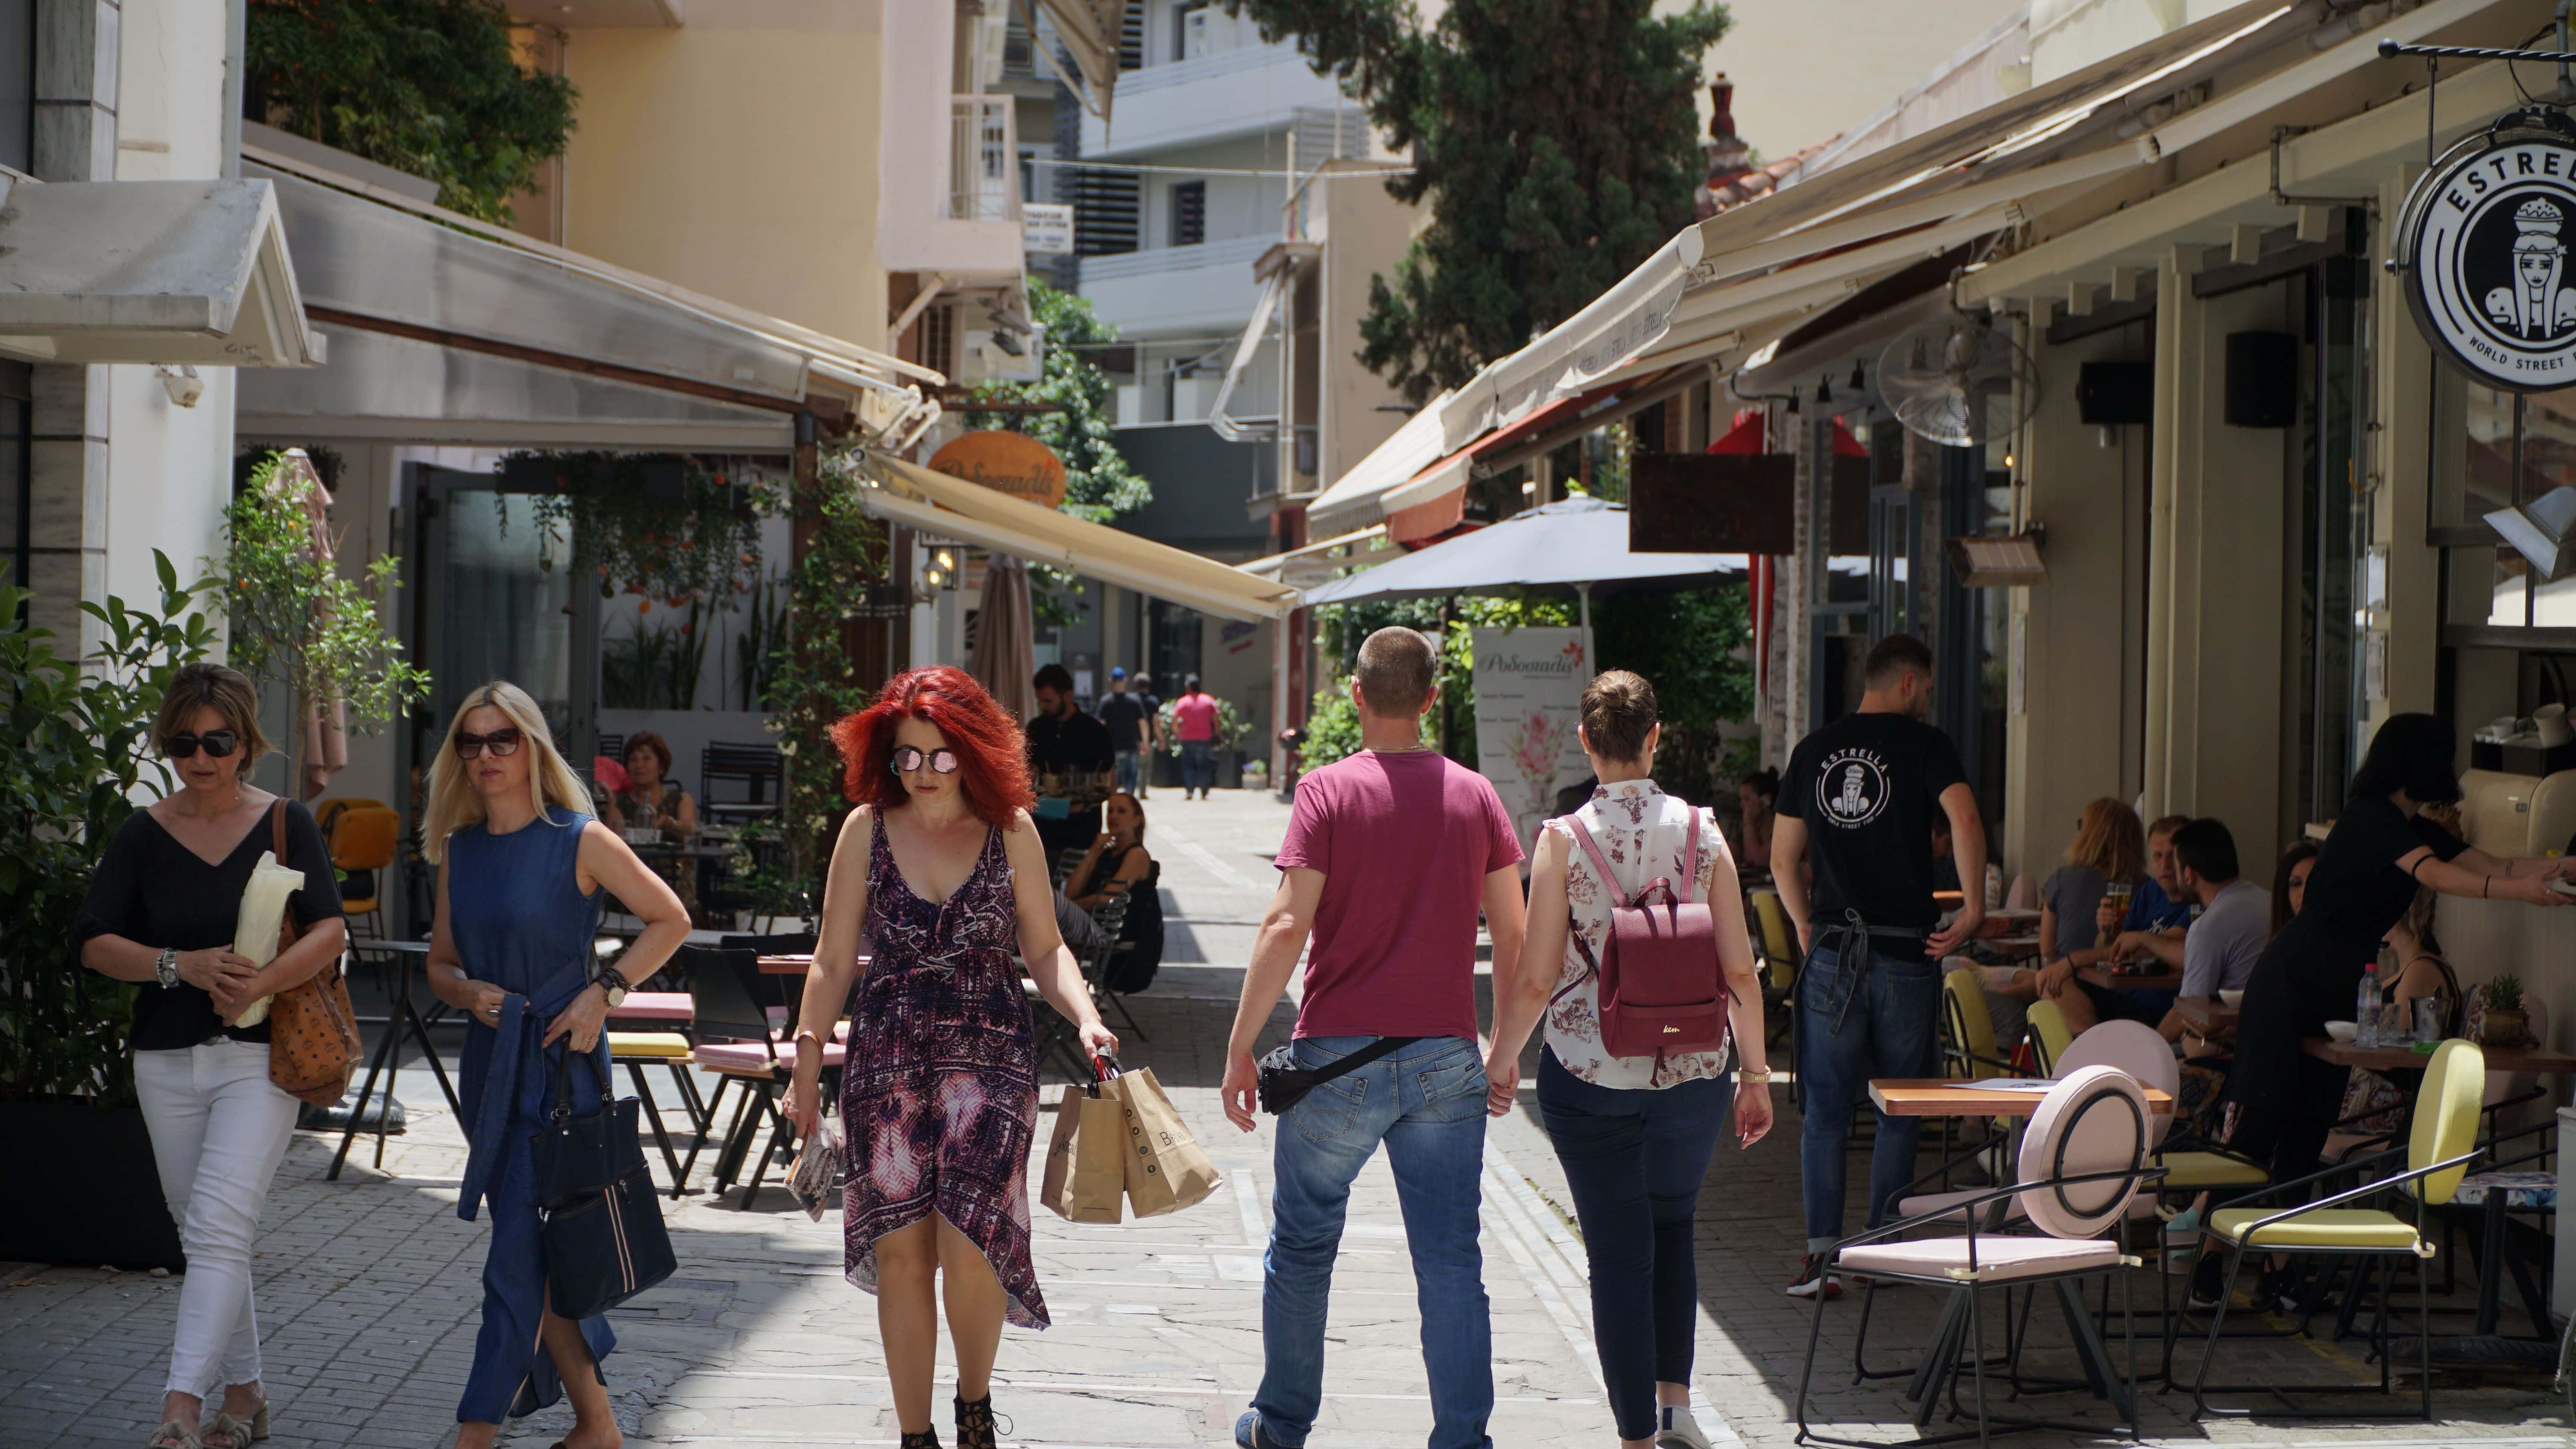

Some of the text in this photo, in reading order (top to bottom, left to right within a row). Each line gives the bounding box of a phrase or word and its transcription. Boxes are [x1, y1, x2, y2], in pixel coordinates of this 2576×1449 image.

[2470, 336, 2564, 370] WORLD STREET
[1821, 748, 1888, 773] ESTRELLA
